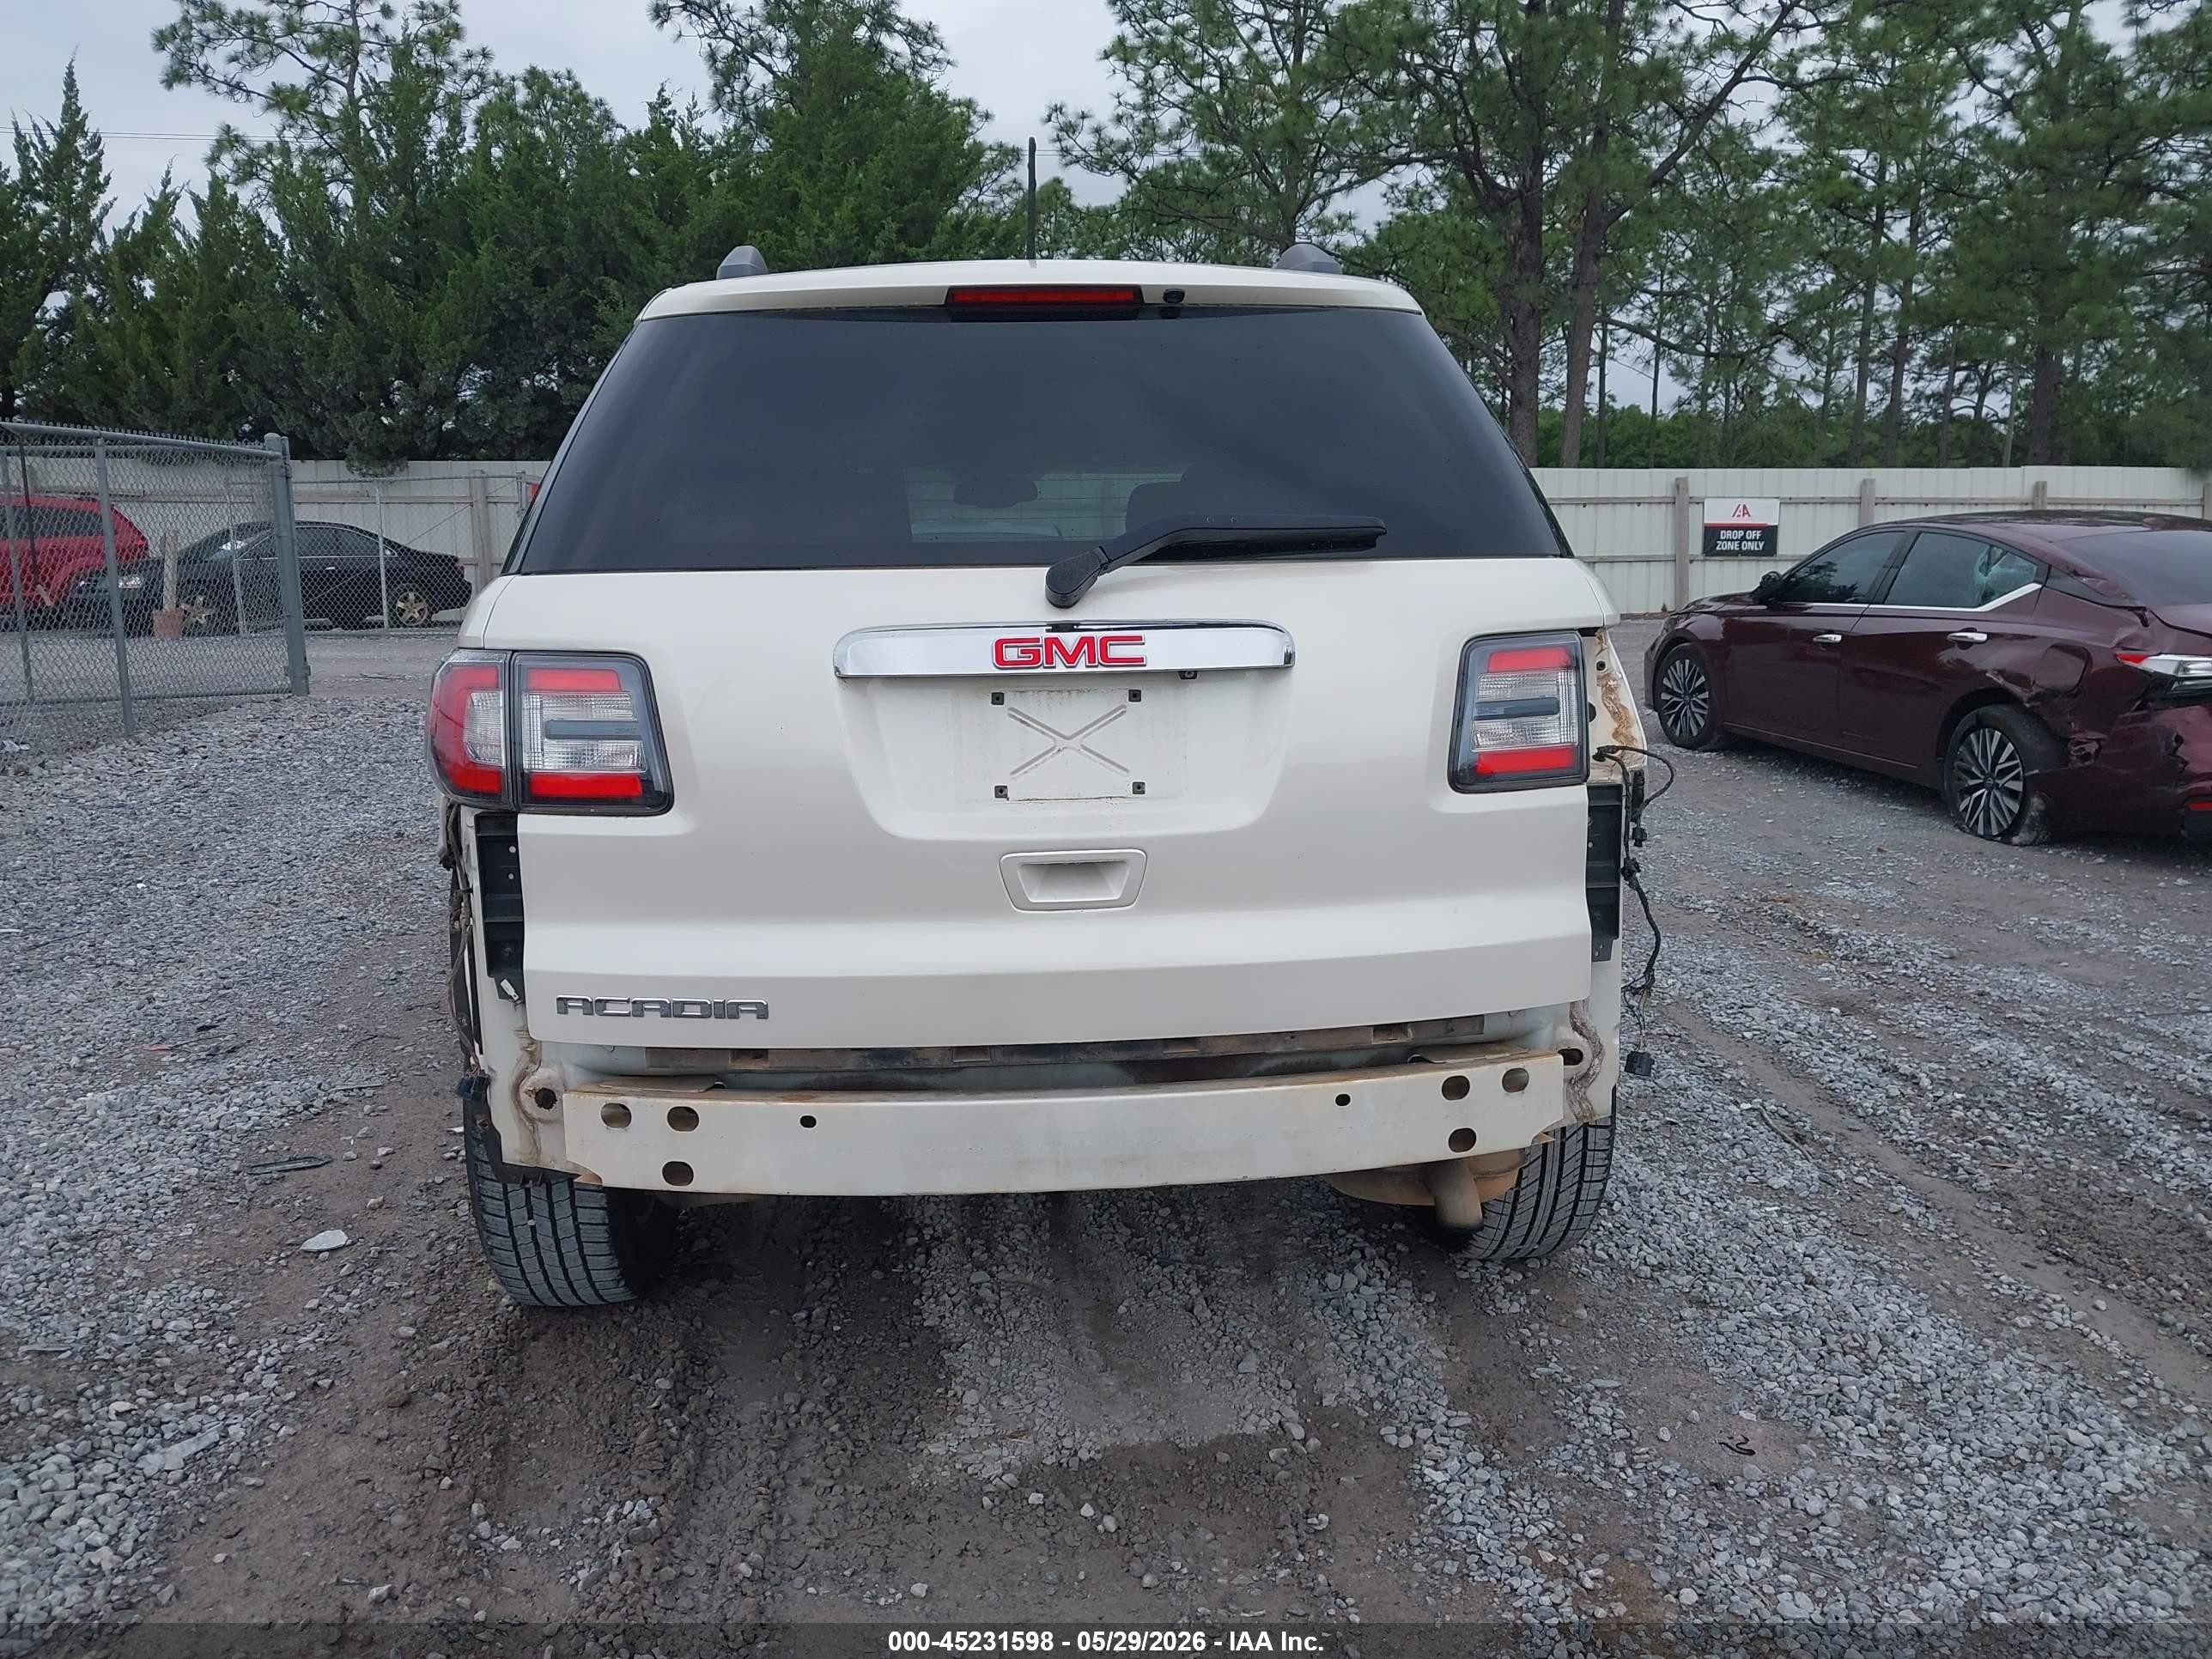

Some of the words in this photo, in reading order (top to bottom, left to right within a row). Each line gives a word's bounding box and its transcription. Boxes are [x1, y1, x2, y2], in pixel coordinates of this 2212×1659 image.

[1720, 530, 1744, 539] DROP
[1746, 530, 1762, 539] OFF
[1716, 541, 1740, 550] ZONE
[1741, 541, 1765, 550] ONLY
[992, 634, 1147, 670] GMC
[556, 994, 769, 1020] ACADIA
